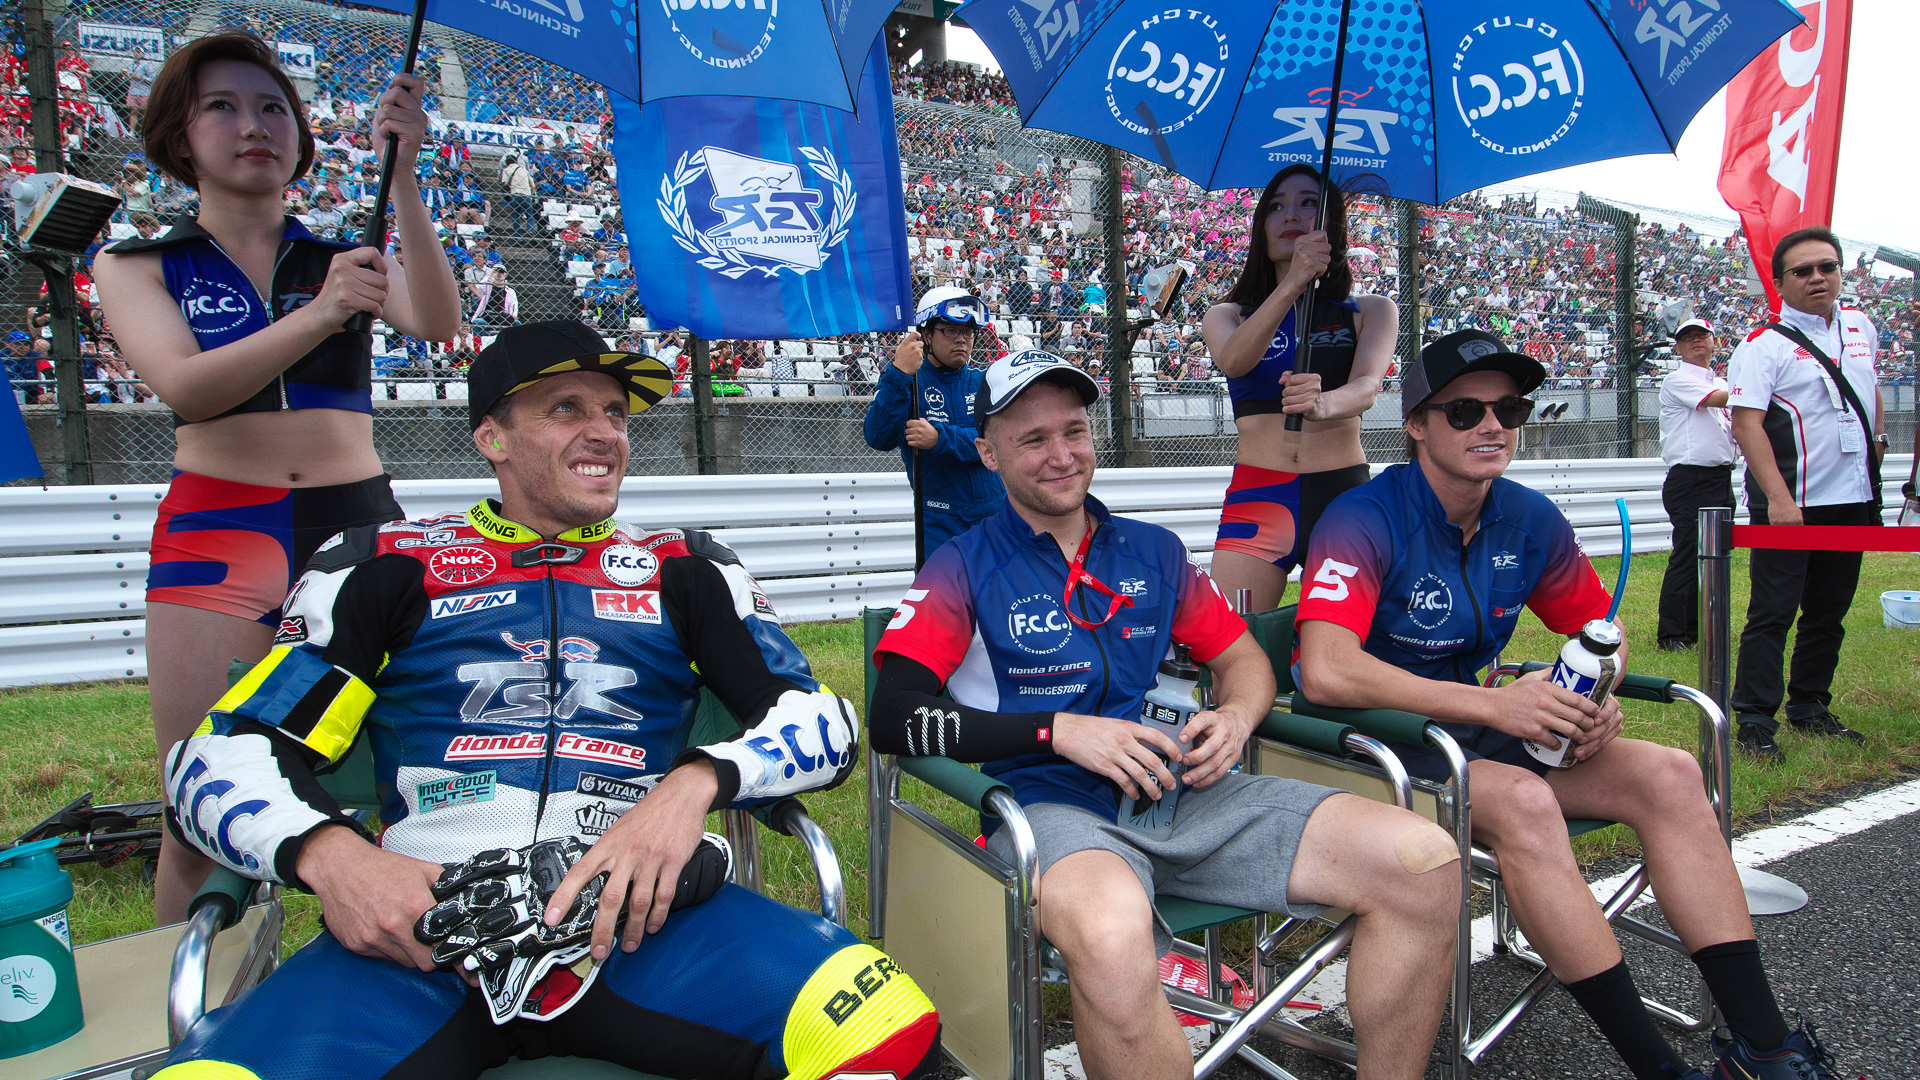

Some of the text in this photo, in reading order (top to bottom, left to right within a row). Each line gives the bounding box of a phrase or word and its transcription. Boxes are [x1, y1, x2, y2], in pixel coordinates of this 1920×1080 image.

[187, 295, 245, 320] F.C.C.
[471, 504, 517, 539] BERING
[441, 555, 485, 565] NGK
[608, 554, 654, 570] F.C.C.
[605, 570, 655, 586] TECHNOLOGY
[1307, 558, 1360, 602] 5
[595, 592, 658, 615] RK
[1013, 610, 1068, 636] F.C.C.
[1121, 626, 1132, 639] 5
[1014, 631, 1073, 655] TECHNOLOGY
[1389, 633, 1465, 647] Honda France
[1008, 661, 1092, 675] Honda France
[457, 661, 644, 721] TSR
[1018, 683, 1088, 696] BRIDGESTONE
[450, 733, 645, 760] Honda France
[745, 712, 849, 786] F.C.C.
[597, 780, 646, 799] YUTAKA
[42, 911, 66, 926] INSIDE
